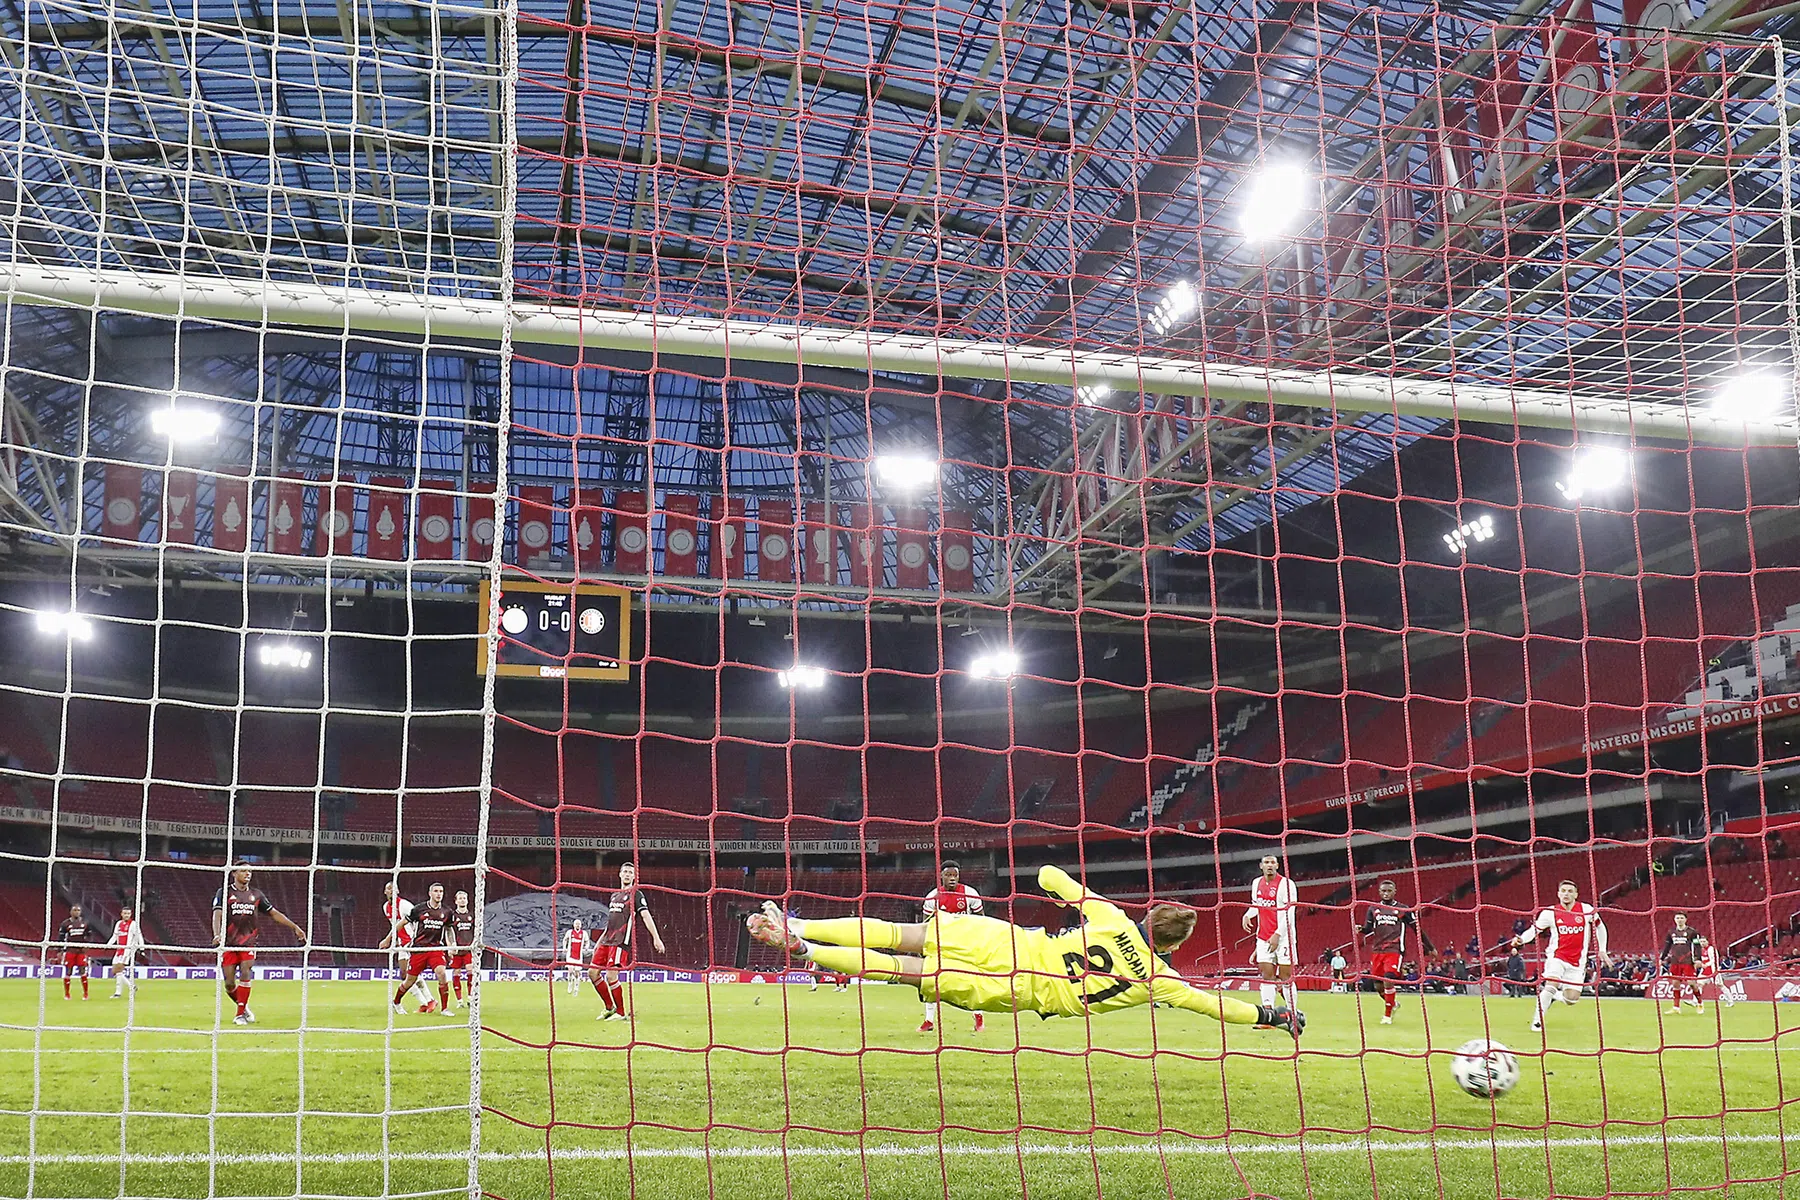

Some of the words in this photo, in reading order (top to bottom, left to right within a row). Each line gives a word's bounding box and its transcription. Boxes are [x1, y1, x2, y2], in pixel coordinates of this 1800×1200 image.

[166, 822, 236, 837] TEGENSTANDER
[239, 827, 266, 838] KAPOT
[333, 832, 356, 842] ALLES
[438, 835, 448, 845] EN
[489, 836, 508, 846] AJAX
[511, 837, 520, 846] IS
[523, 837, 533, 847] DE
[536, 838, 593, 848] SUCCSVOLSTE
[596, 839, 616, 849] CLUB
[619, 840, 629, 849] EN
[649, 840, 657, 849] JE
[660, 840, 674, 849] DAT
[678, 841, 694, 850] DAN
[720, 842, 747, 851] VINDEN
[803, 842, 820, 851] NIET
[942, 841, 961, 849] CUP
[231, 901, 255, 910] droom
[1113, 931, 1148, 980] MARSMAN
[7, 965, 21, 977] pci
[152, 968, 169, 978] pci
[191, 968, 208, 978] pci
[269, 969, 285, 979] pci
[344, 970, 362, 980] pci
[1062, 944, 1133, 1006] 21
